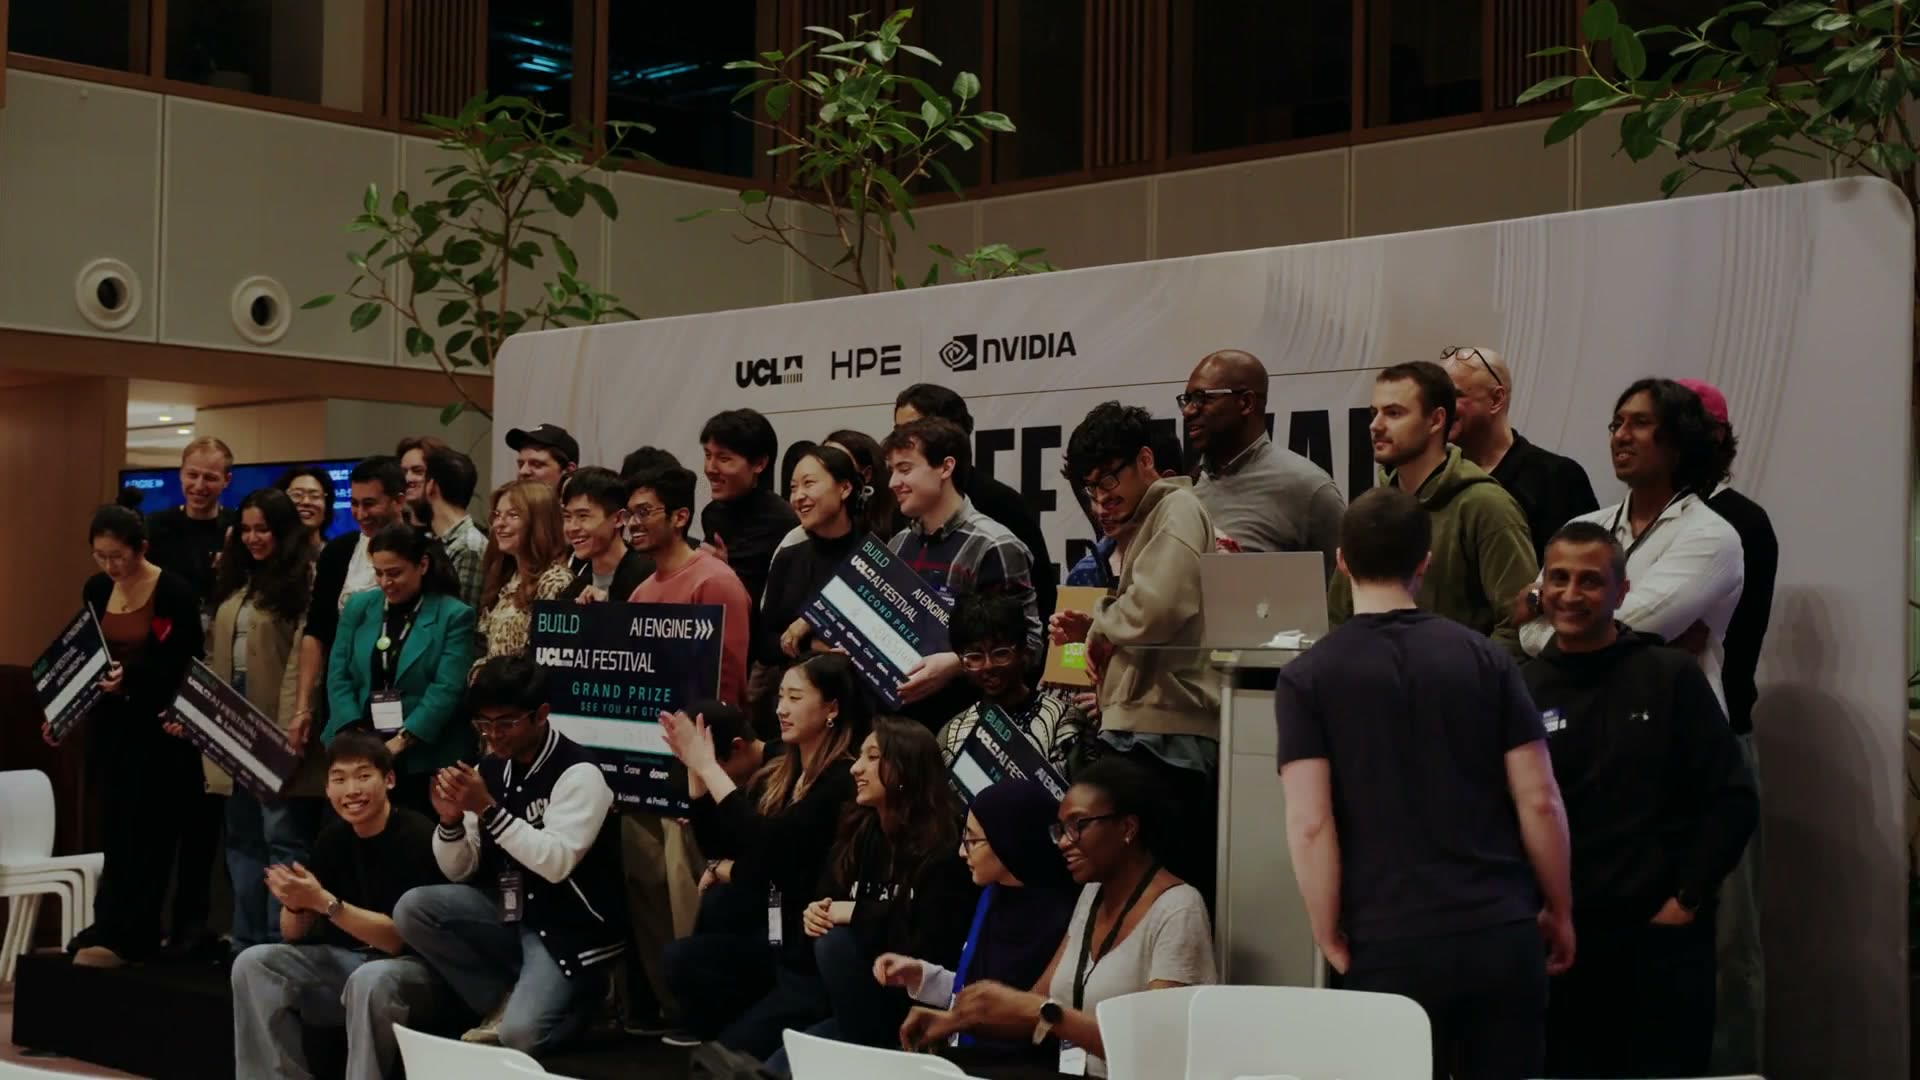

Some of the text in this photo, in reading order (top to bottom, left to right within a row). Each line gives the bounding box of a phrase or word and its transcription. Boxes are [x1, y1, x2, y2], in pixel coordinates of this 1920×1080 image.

[736, 358, 782, 388] UCL
[831, 345, 901, 380] HPE
[862, 540, 891, 568] BUILD
[871, 575, 885, 592] AI
[879, 583, 920, 624] FESTIVAL
[911, 588, 923, 602] AI
[537, 612, 581, 634] BUILD
[629, 617, 694, 640] AI ENGINE
[856, 584, 921, 645] SECOND PRIZE
[535, 646, 656, 674] UCL AI FESTIVAL
[571, 681, 672, 703] GRAND PRIZE
[580, 701, 599, 713] SEE
[602, 703, 622, 714] YOU
[625, 705, 638, 717] AT
[985, 709, 1012, 742] BUILD
